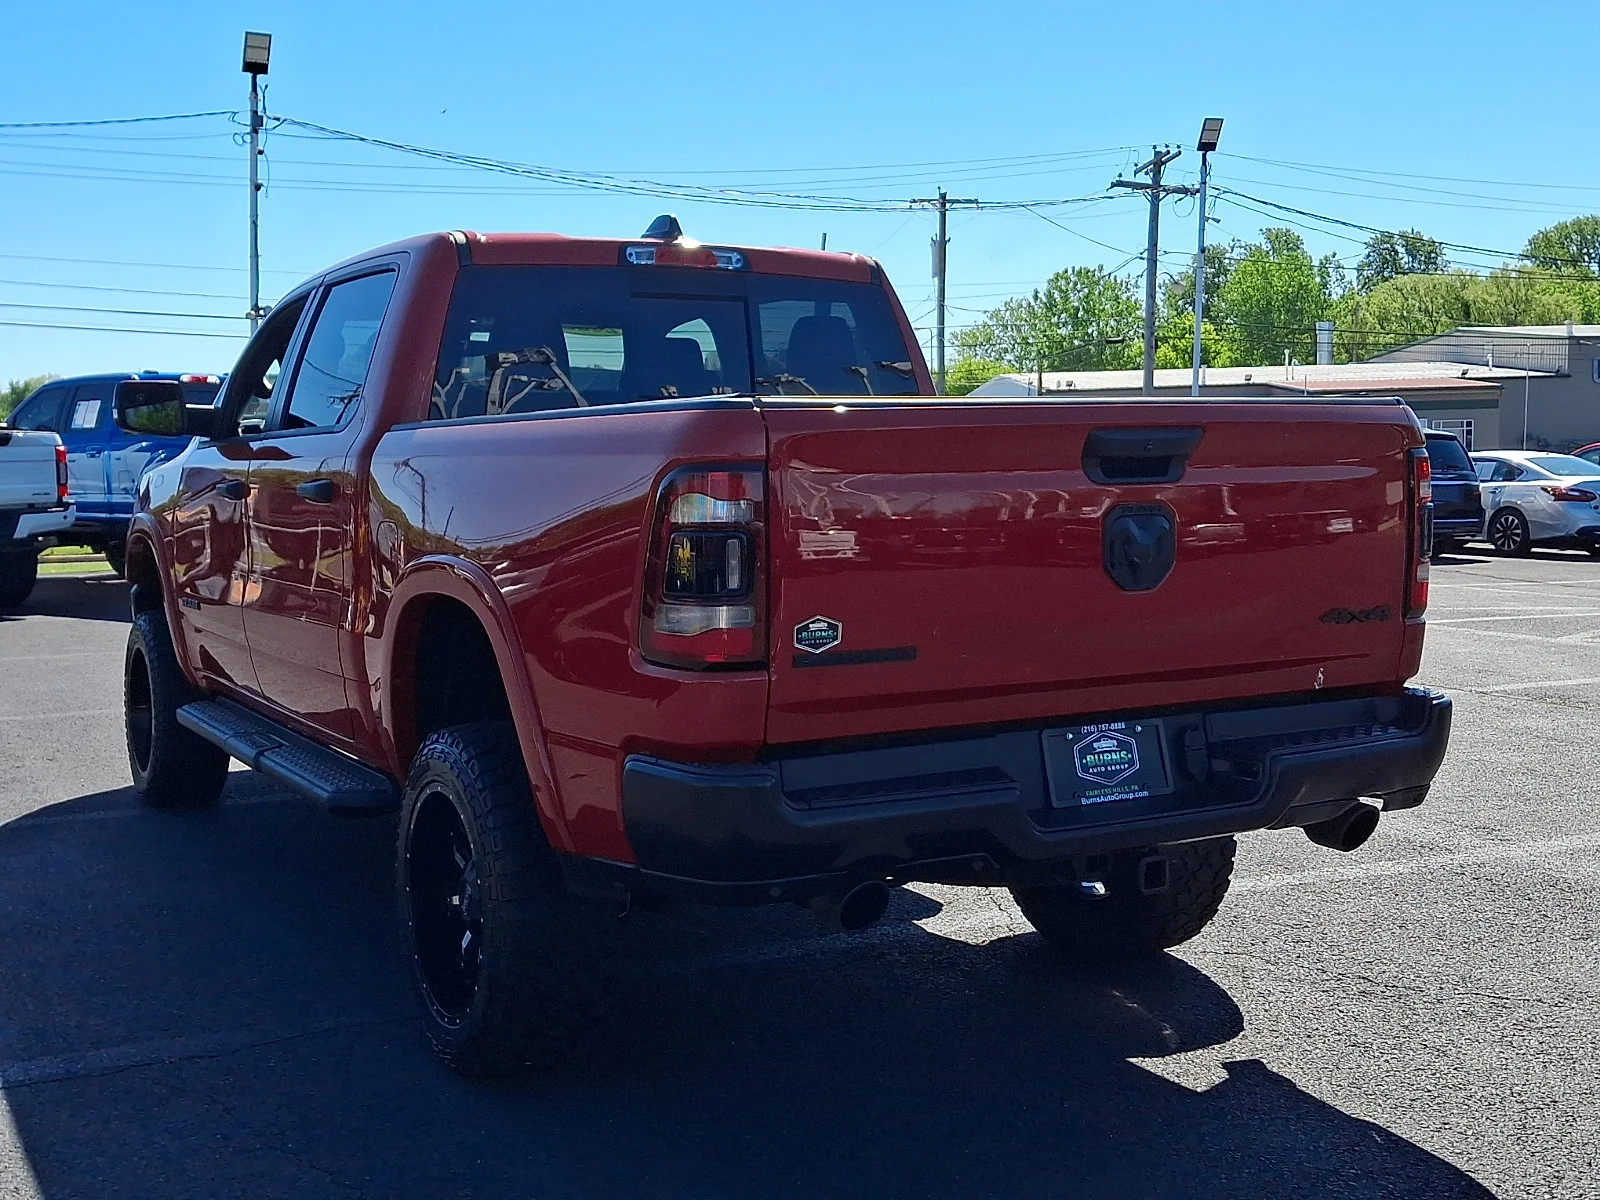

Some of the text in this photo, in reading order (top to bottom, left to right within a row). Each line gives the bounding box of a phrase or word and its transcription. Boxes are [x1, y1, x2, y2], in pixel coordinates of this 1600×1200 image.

[802, 630, 833, 640] BURNS
[1081, 724, 1097, 735] (215)
[1086, 751, 1128, 767] BURNS
[1107, 763, 1129, 772] GROUP
[1081, 791, 1149, 805] BurnsAutoGroup.com
